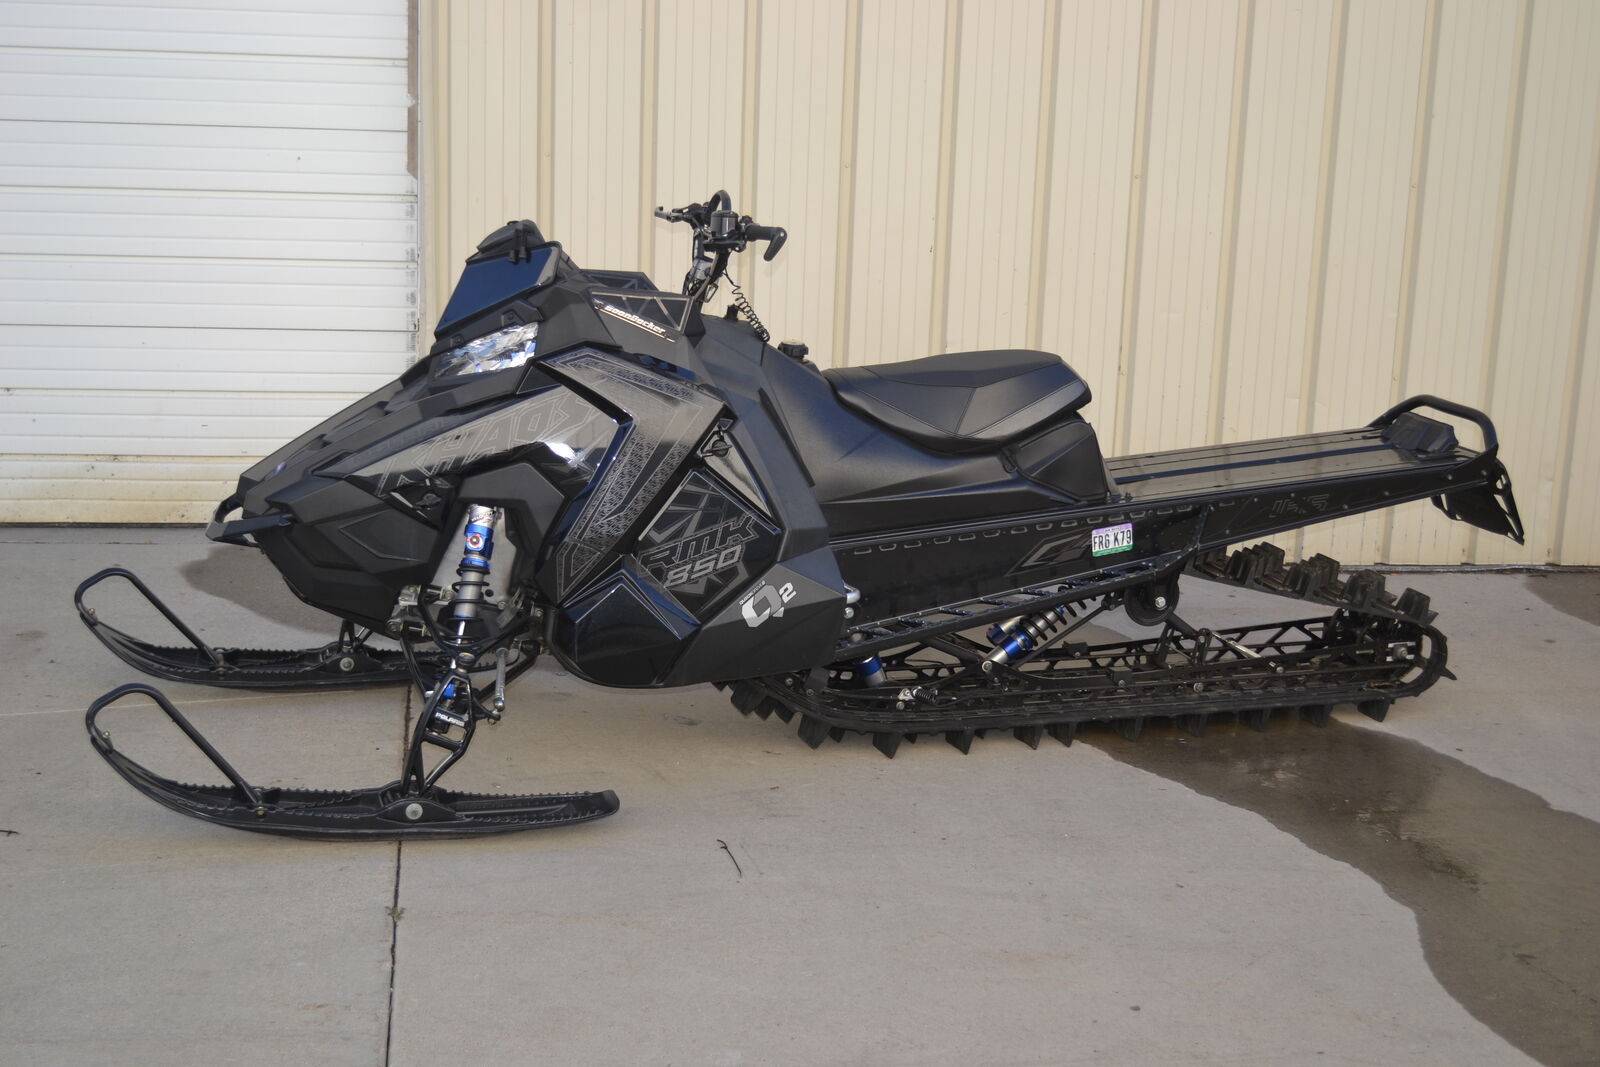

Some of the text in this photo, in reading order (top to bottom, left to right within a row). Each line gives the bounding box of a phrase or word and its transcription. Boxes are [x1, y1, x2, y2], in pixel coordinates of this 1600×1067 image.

[638, 513, 758, 576] RMK
[1113, 529, 1132, 547] K79
[664, 545, 744, 588] 850
